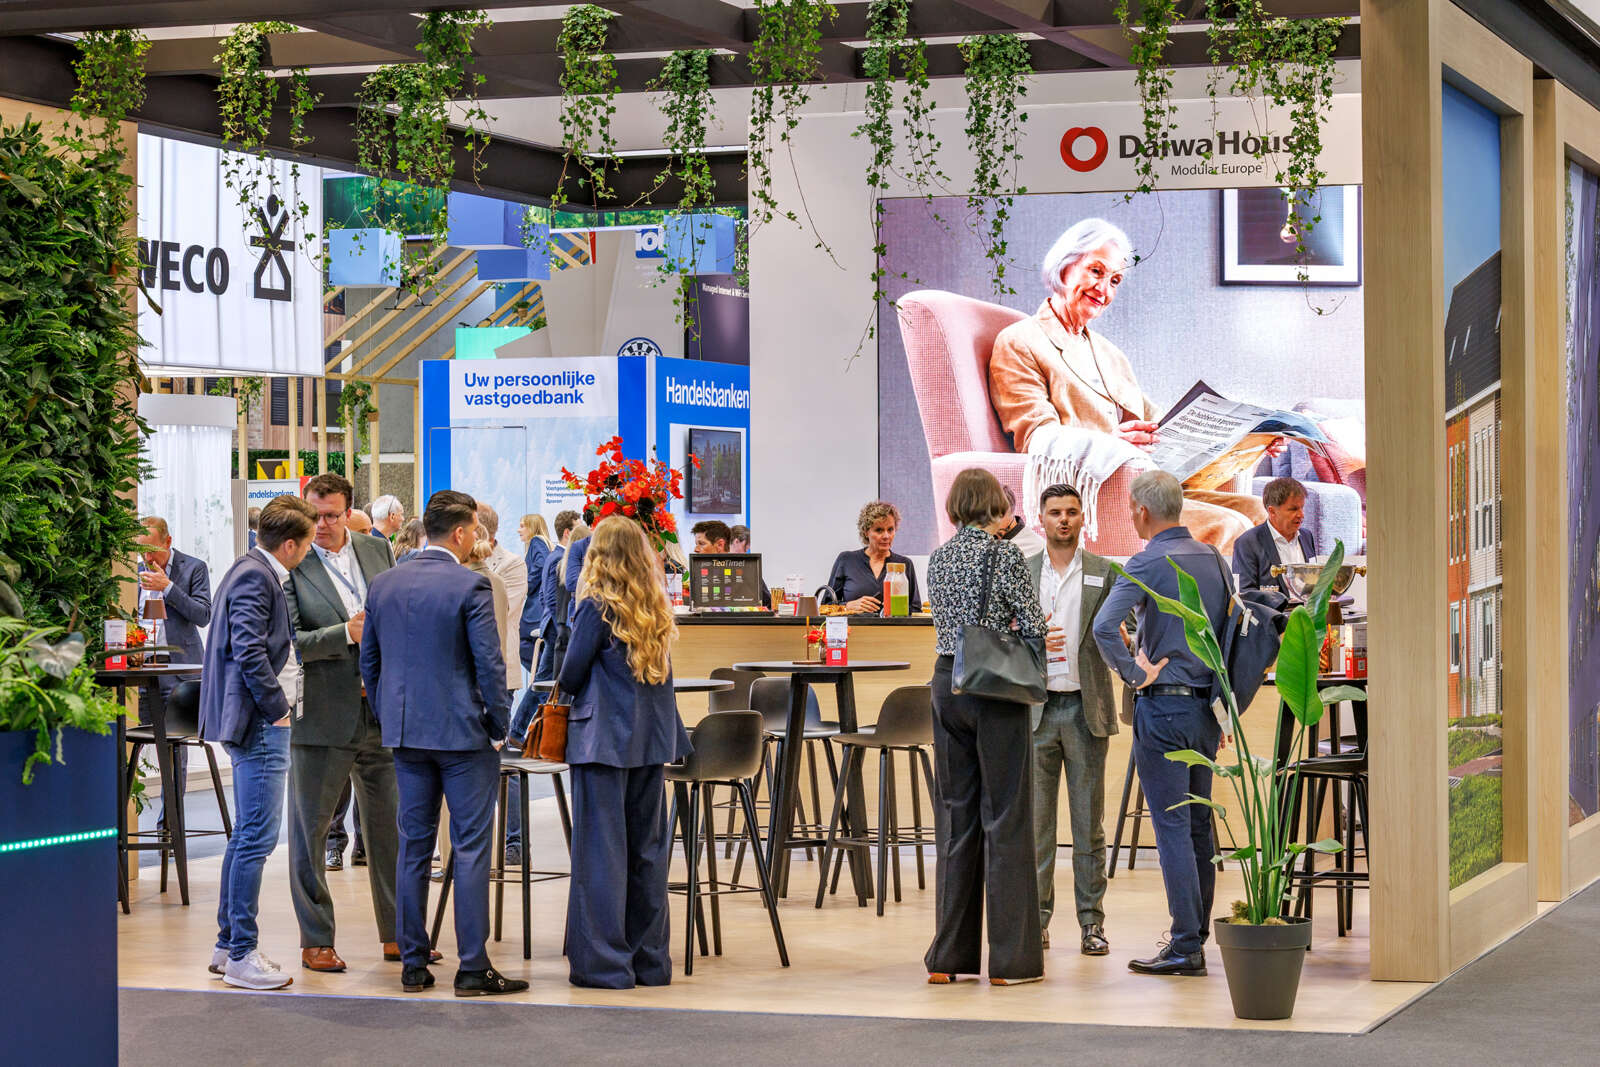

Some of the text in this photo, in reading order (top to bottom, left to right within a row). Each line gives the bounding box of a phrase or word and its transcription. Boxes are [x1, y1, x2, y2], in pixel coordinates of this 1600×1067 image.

[1119, 131, 1299, 158] Daiwa Hous
[1171, 164, 1263, 176] Modular Europe
[464, 371, 595, 389] Uw persoonlijke
[464, 389, 584, 408] vastgoedbank
[666, 376, 750, 409] Handelsbanken
